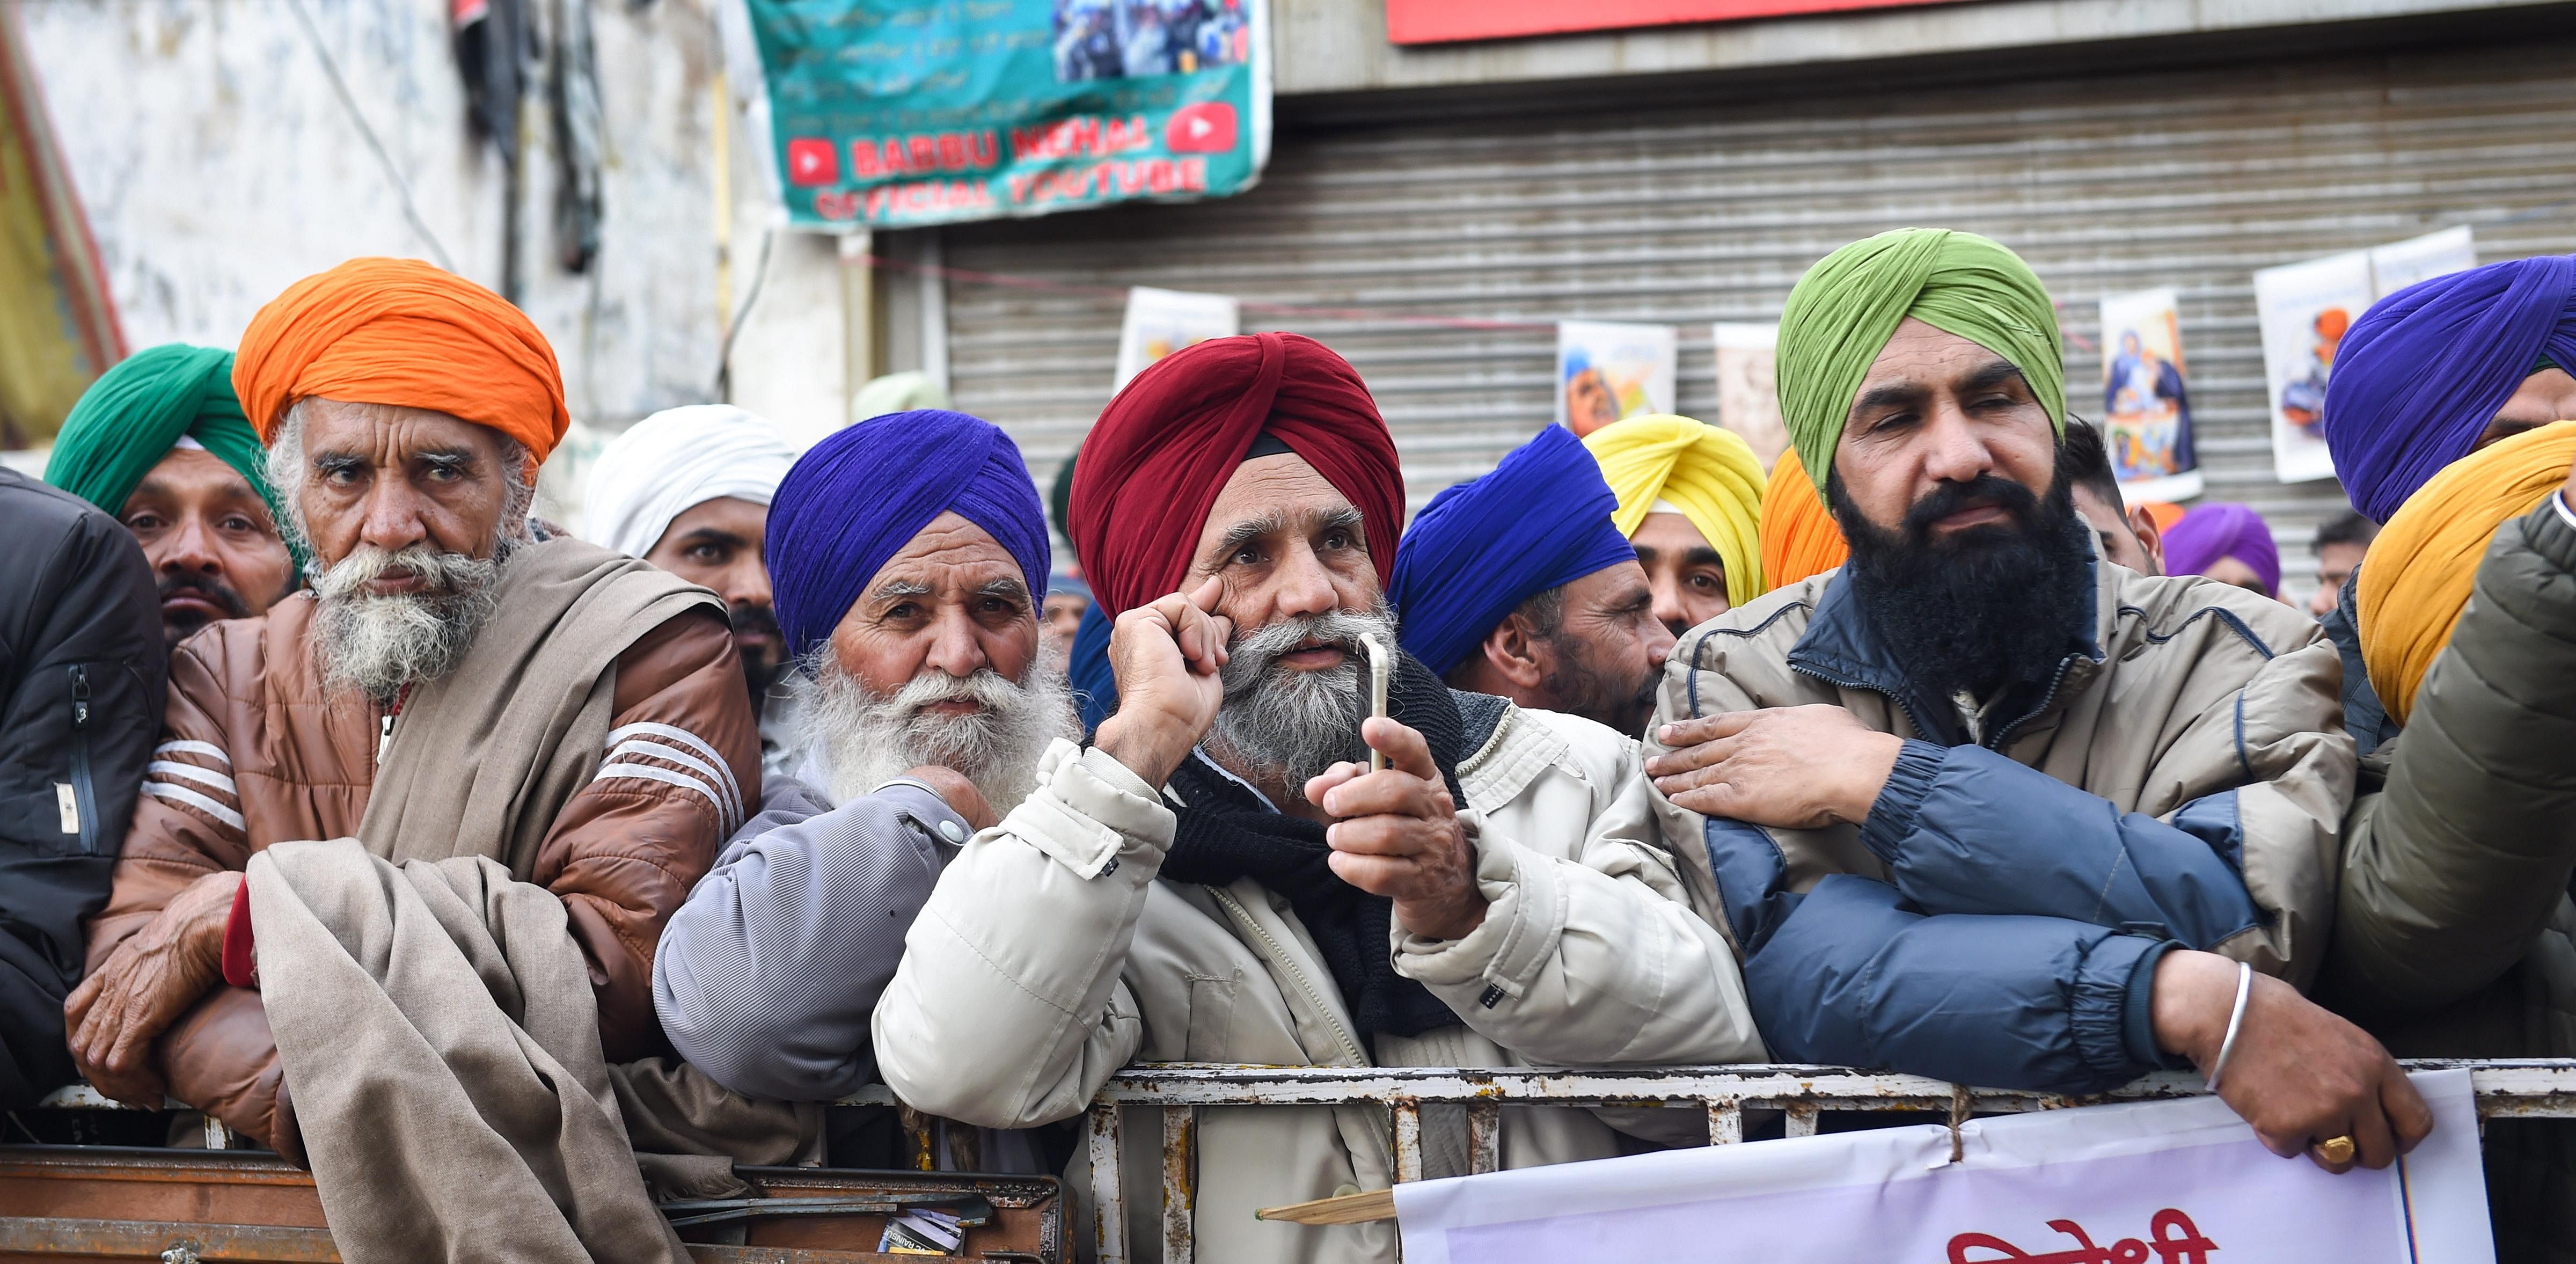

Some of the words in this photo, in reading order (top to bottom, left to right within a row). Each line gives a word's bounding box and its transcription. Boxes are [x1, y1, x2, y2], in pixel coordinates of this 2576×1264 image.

[849, 129, 998, 179] BABBU
[814, 178, 993, 220] OFFICIAL
[1009, 157, 1206, 205] YOUTUBE
